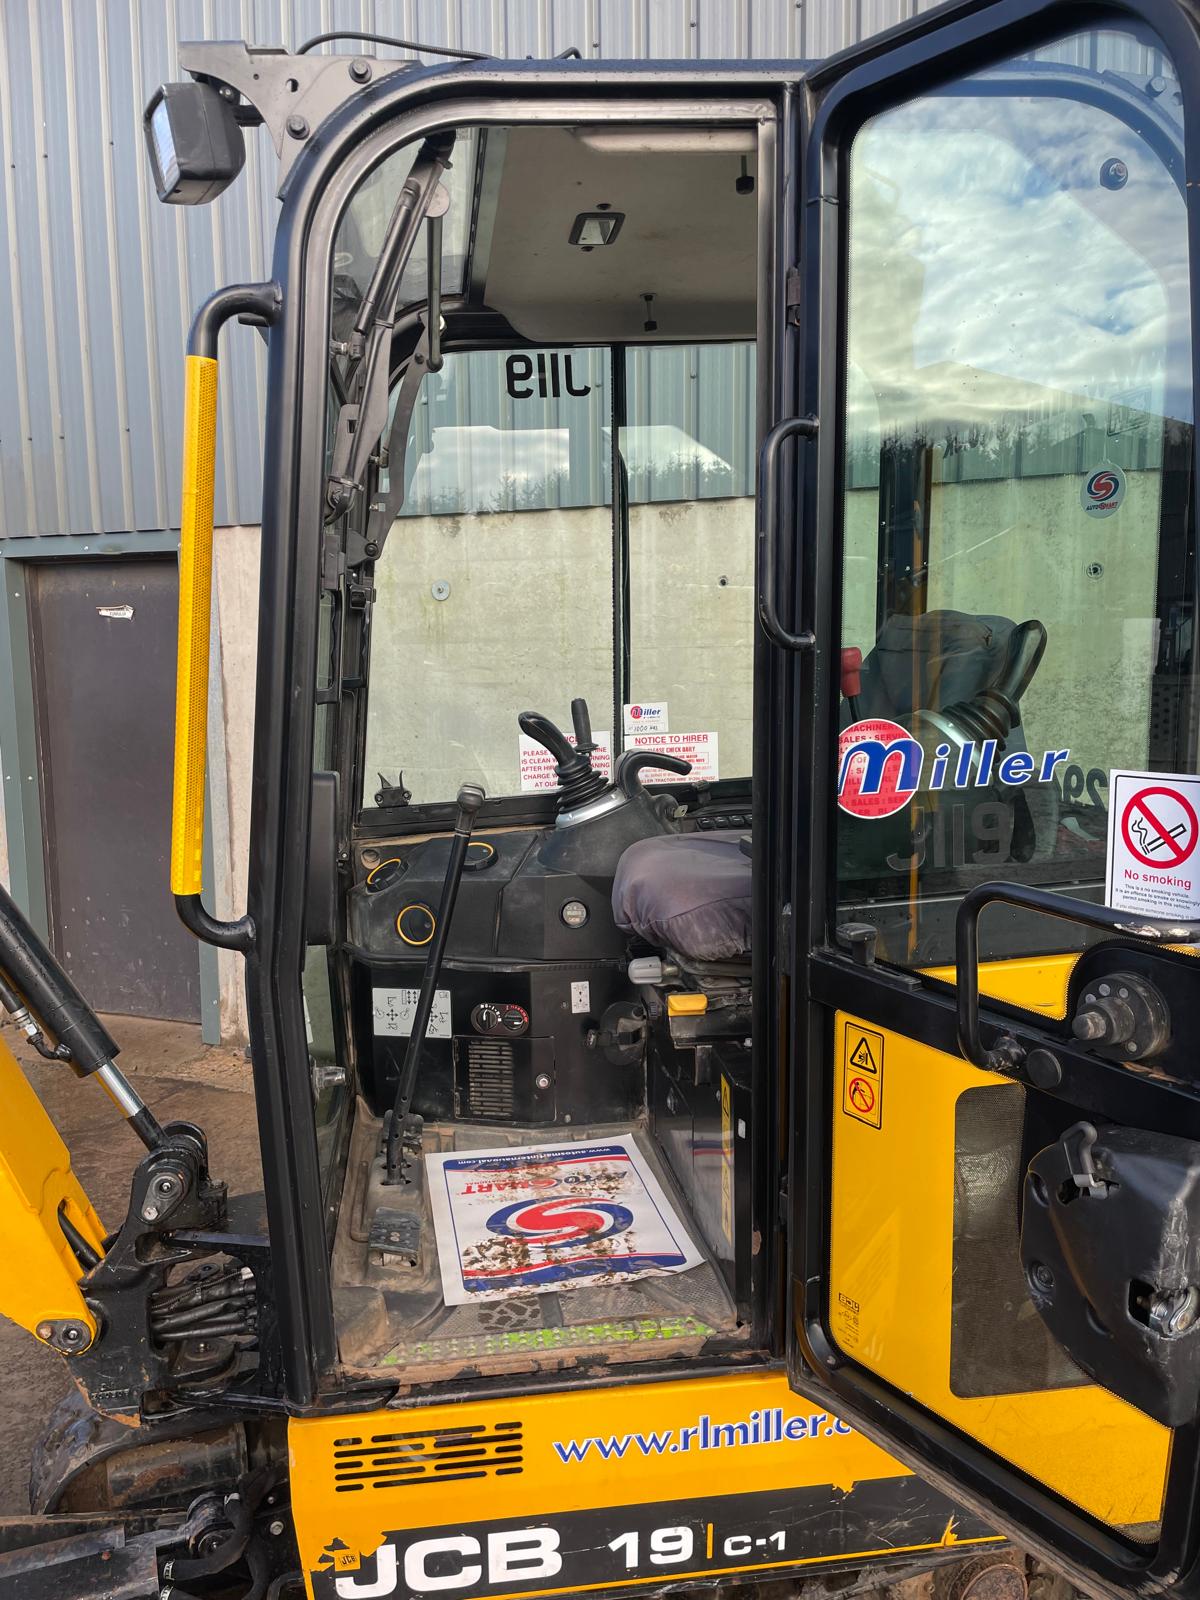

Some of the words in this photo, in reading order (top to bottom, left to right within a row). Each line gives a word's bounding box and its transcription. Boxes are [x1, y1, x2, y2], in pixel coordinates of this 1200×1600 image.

[635, 736, 666, 745] NOTICE
[670, 735, 681, 743] TO
[682, 734, 709, 743] HIRER
[1124, 869, 1139, 881] No
[1142, 873, 1192, 891] smoking
[1151, 888, 1171, 896] smoking
[1138, 897, 1157, 905] smoking
[335, 1526, 563, 1600] JCB
[608, 1525, 694, 1568] 19
[341, 1554, 356, 1566] JCB
